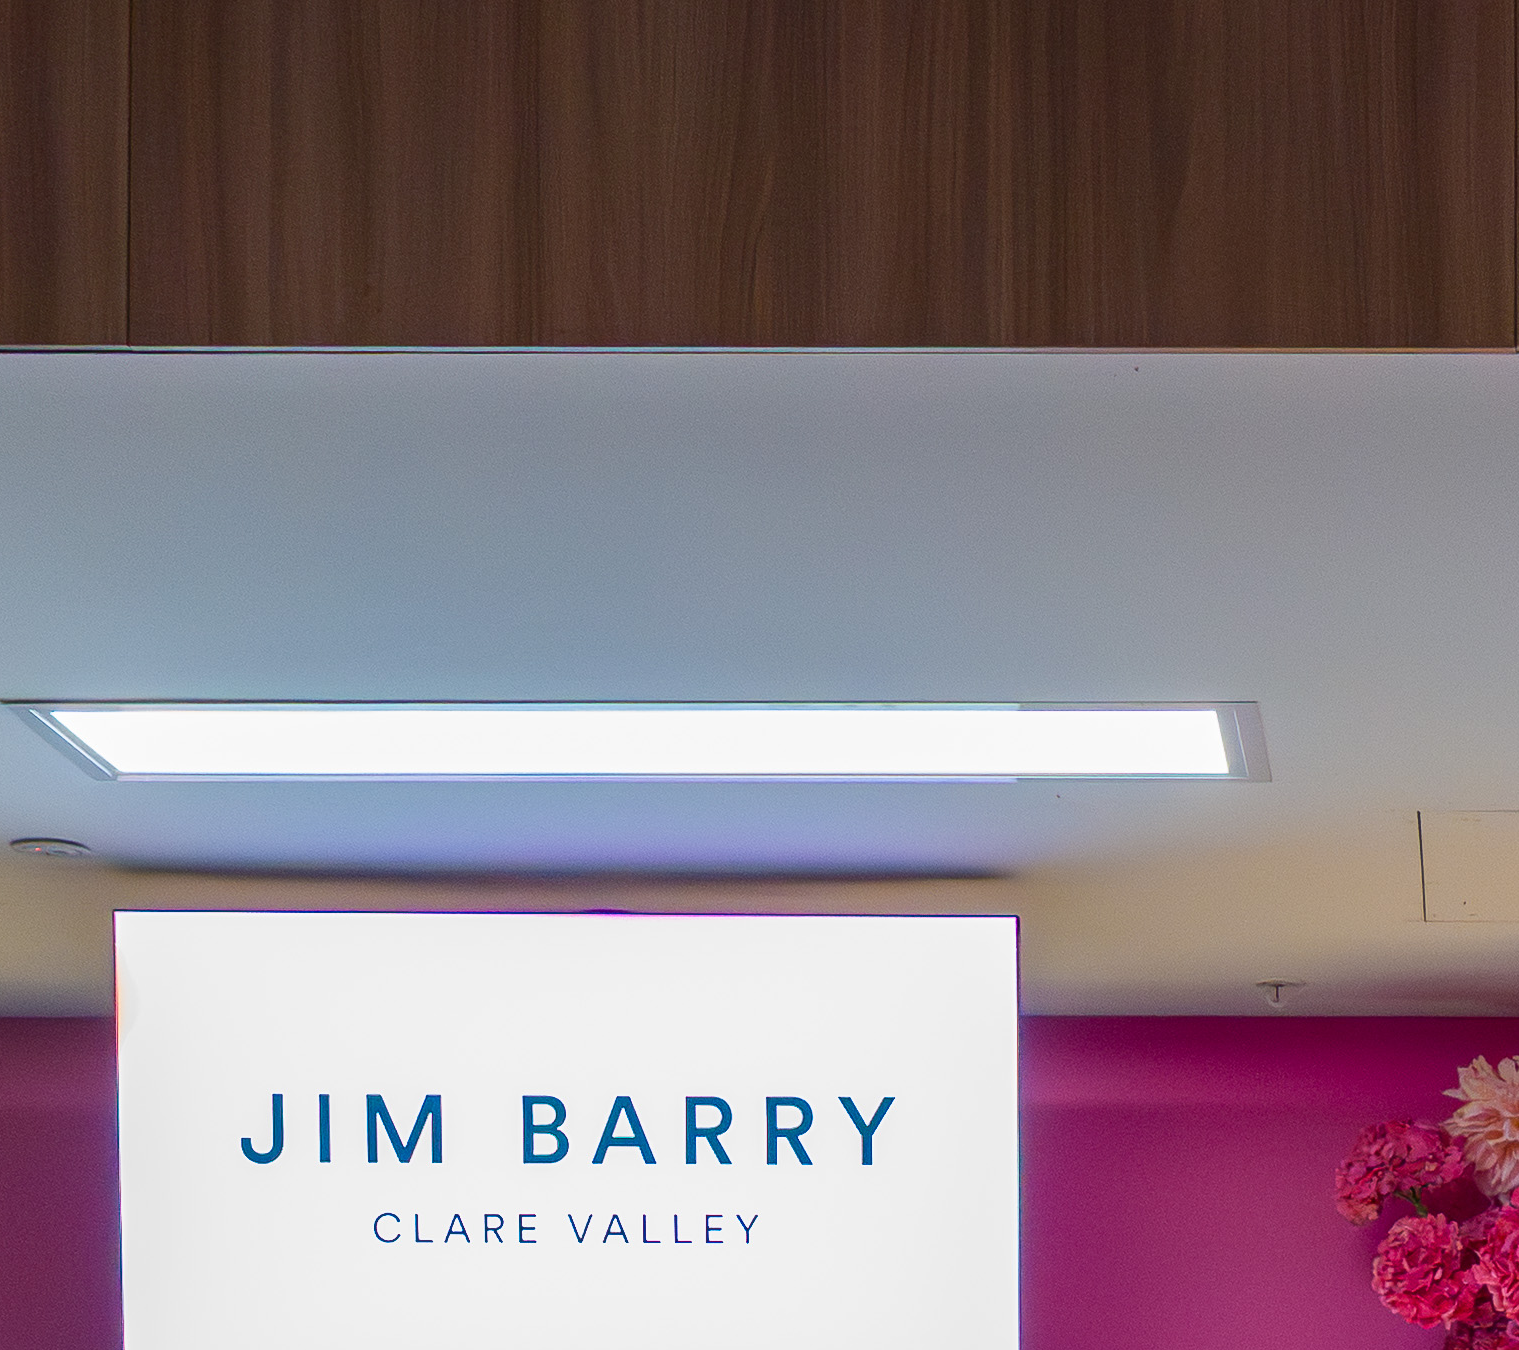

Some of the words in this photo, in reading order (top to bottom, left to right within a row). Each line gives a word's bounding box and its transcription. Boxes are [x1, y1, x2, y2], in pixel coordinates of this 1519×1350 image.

[241, 1093, 443, 1164] JIM
[522, 1094, 896, 1166] BARRY
[373, 1212, 538, 1244] CLARE
[568, 1212, 760, 1244] VALLEY
